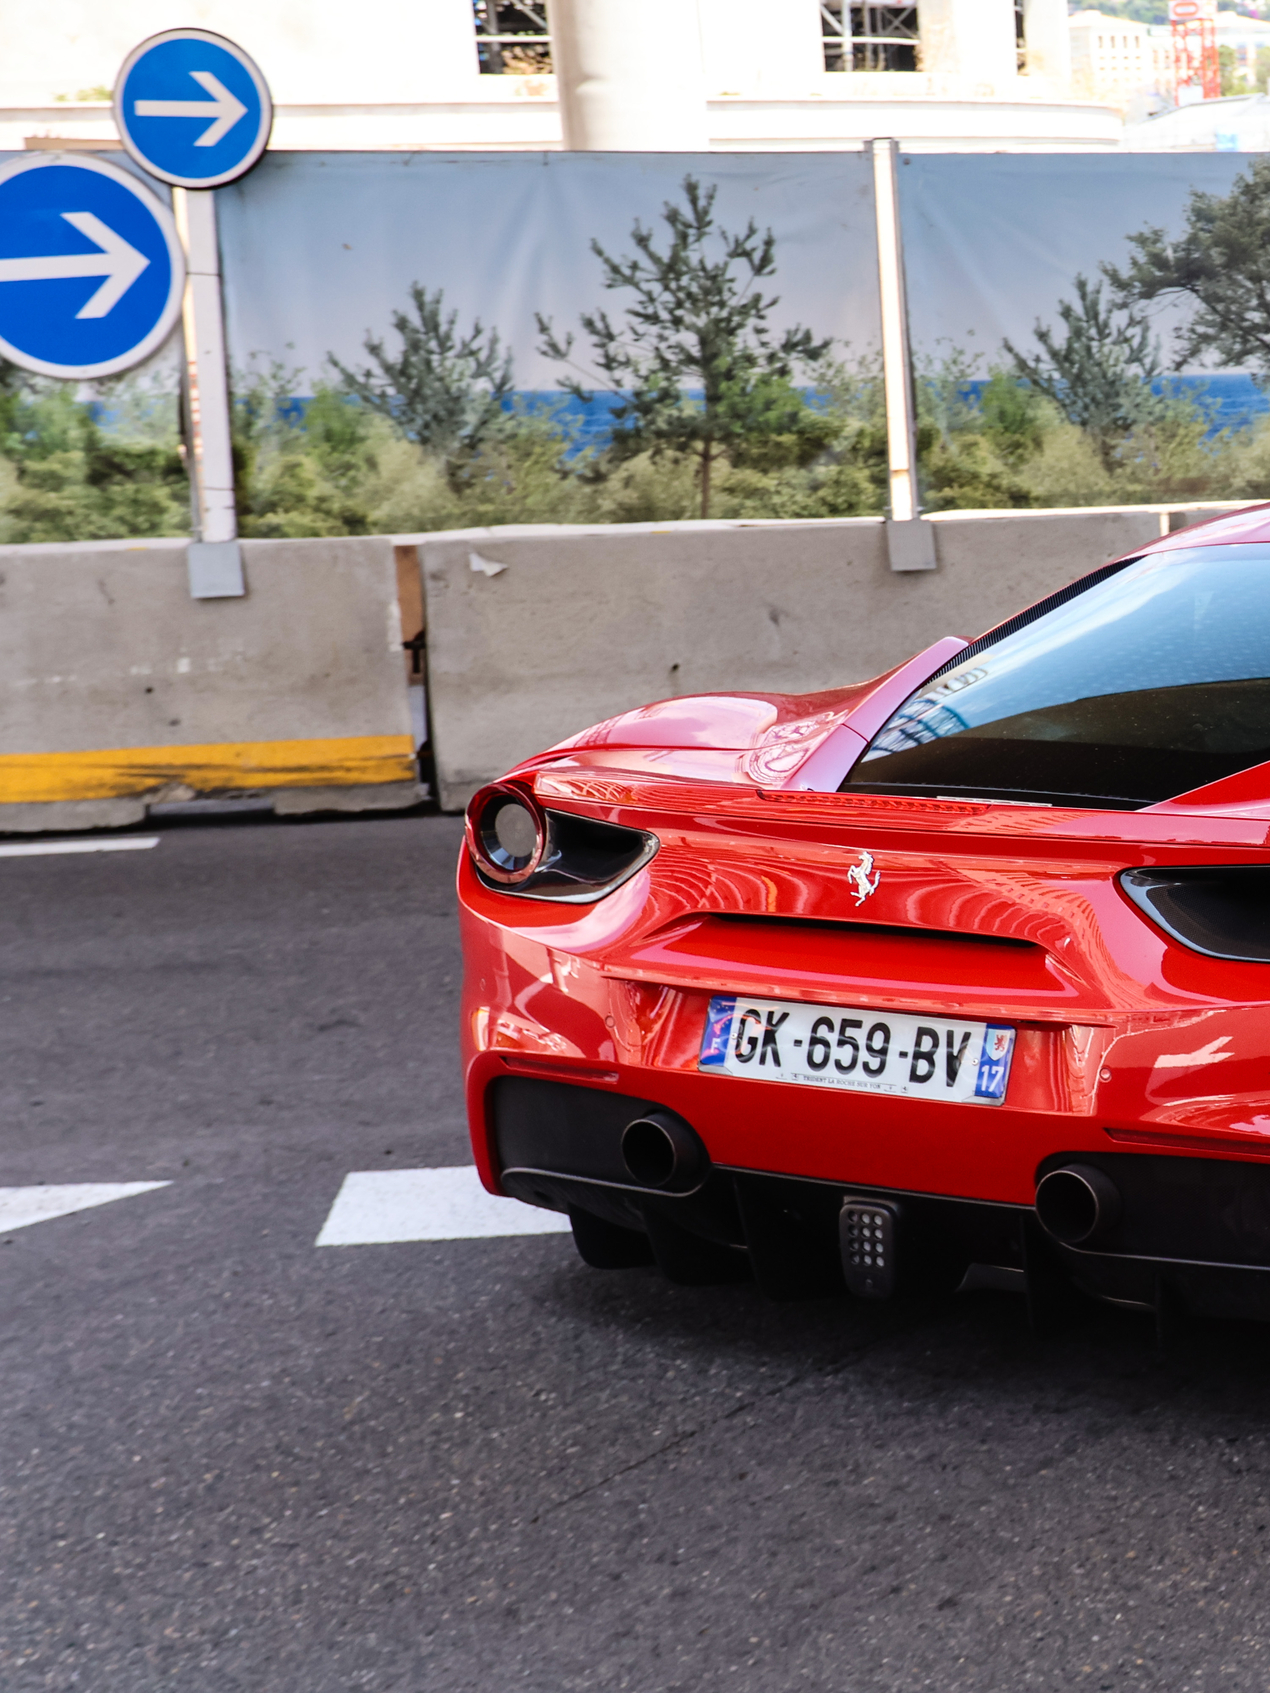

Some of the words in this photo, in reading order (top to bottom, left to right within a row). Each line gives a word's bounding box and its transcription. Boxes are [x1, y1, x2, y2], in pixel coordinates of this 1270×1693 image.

[710, 1038, 720, 1053] F
[837, 1079, 855, 1087] ROCHE
[981, 1065, 1005, 1093] 17
